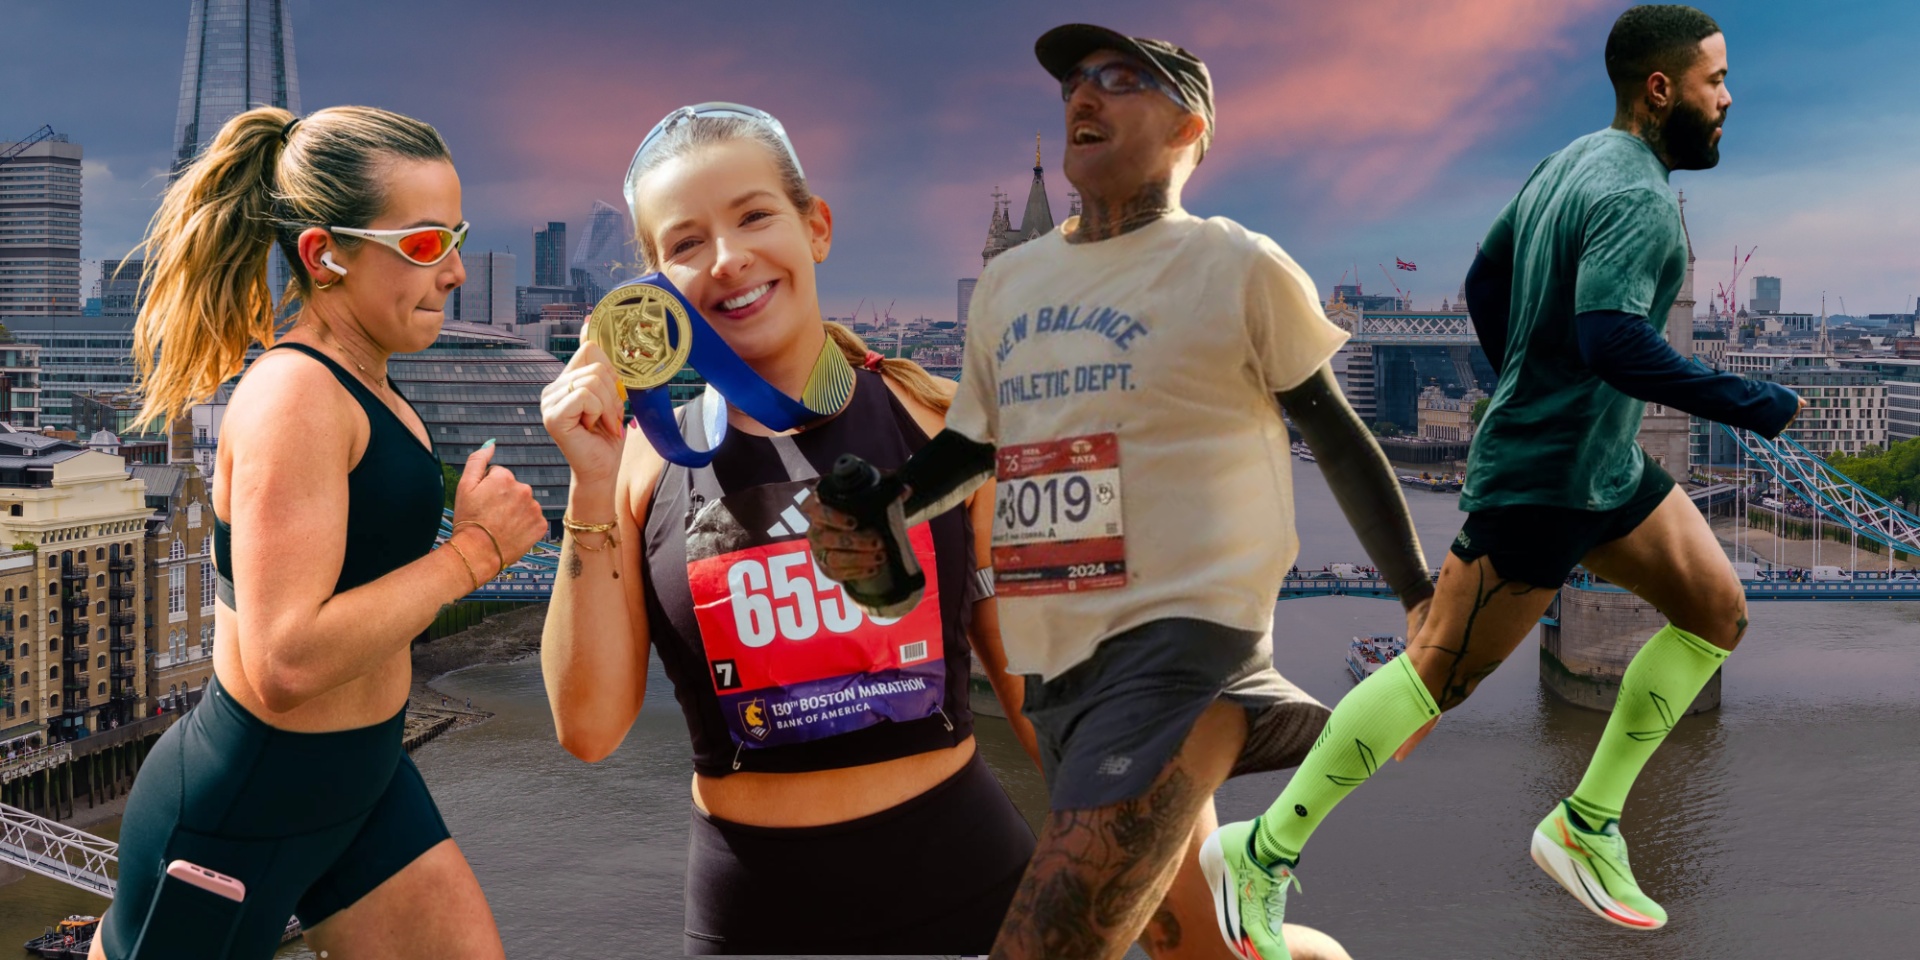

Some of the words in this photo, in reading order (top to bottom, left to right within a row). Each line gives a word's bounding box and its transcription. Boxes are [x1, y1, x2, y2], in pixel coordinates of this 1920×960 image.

[602, 288, 637, 308] BOSTON
[640, 287, 684, 318] MARATHON
[996, 313, 1027, 368] NEW
[1036, 304, 1148, 351] BALANCE
[1074, 362, 1136, 393] DEPT.
[1069, 454, 1097, 464] TATA
[1068, 563, 1106, 578] 2024
[727, 550, 902, 648] 655
[716, 663, 733, 687] 7
[771, 700, 799, 717] 130TH
[799, 687, 856, 713] BOSTON
[857, 677, 927, 700] MARATHON
[776, 717, 803, 730] BANK
[806, 713, 818, 724] OF
[819, 702, 871, 720] AMERICA
